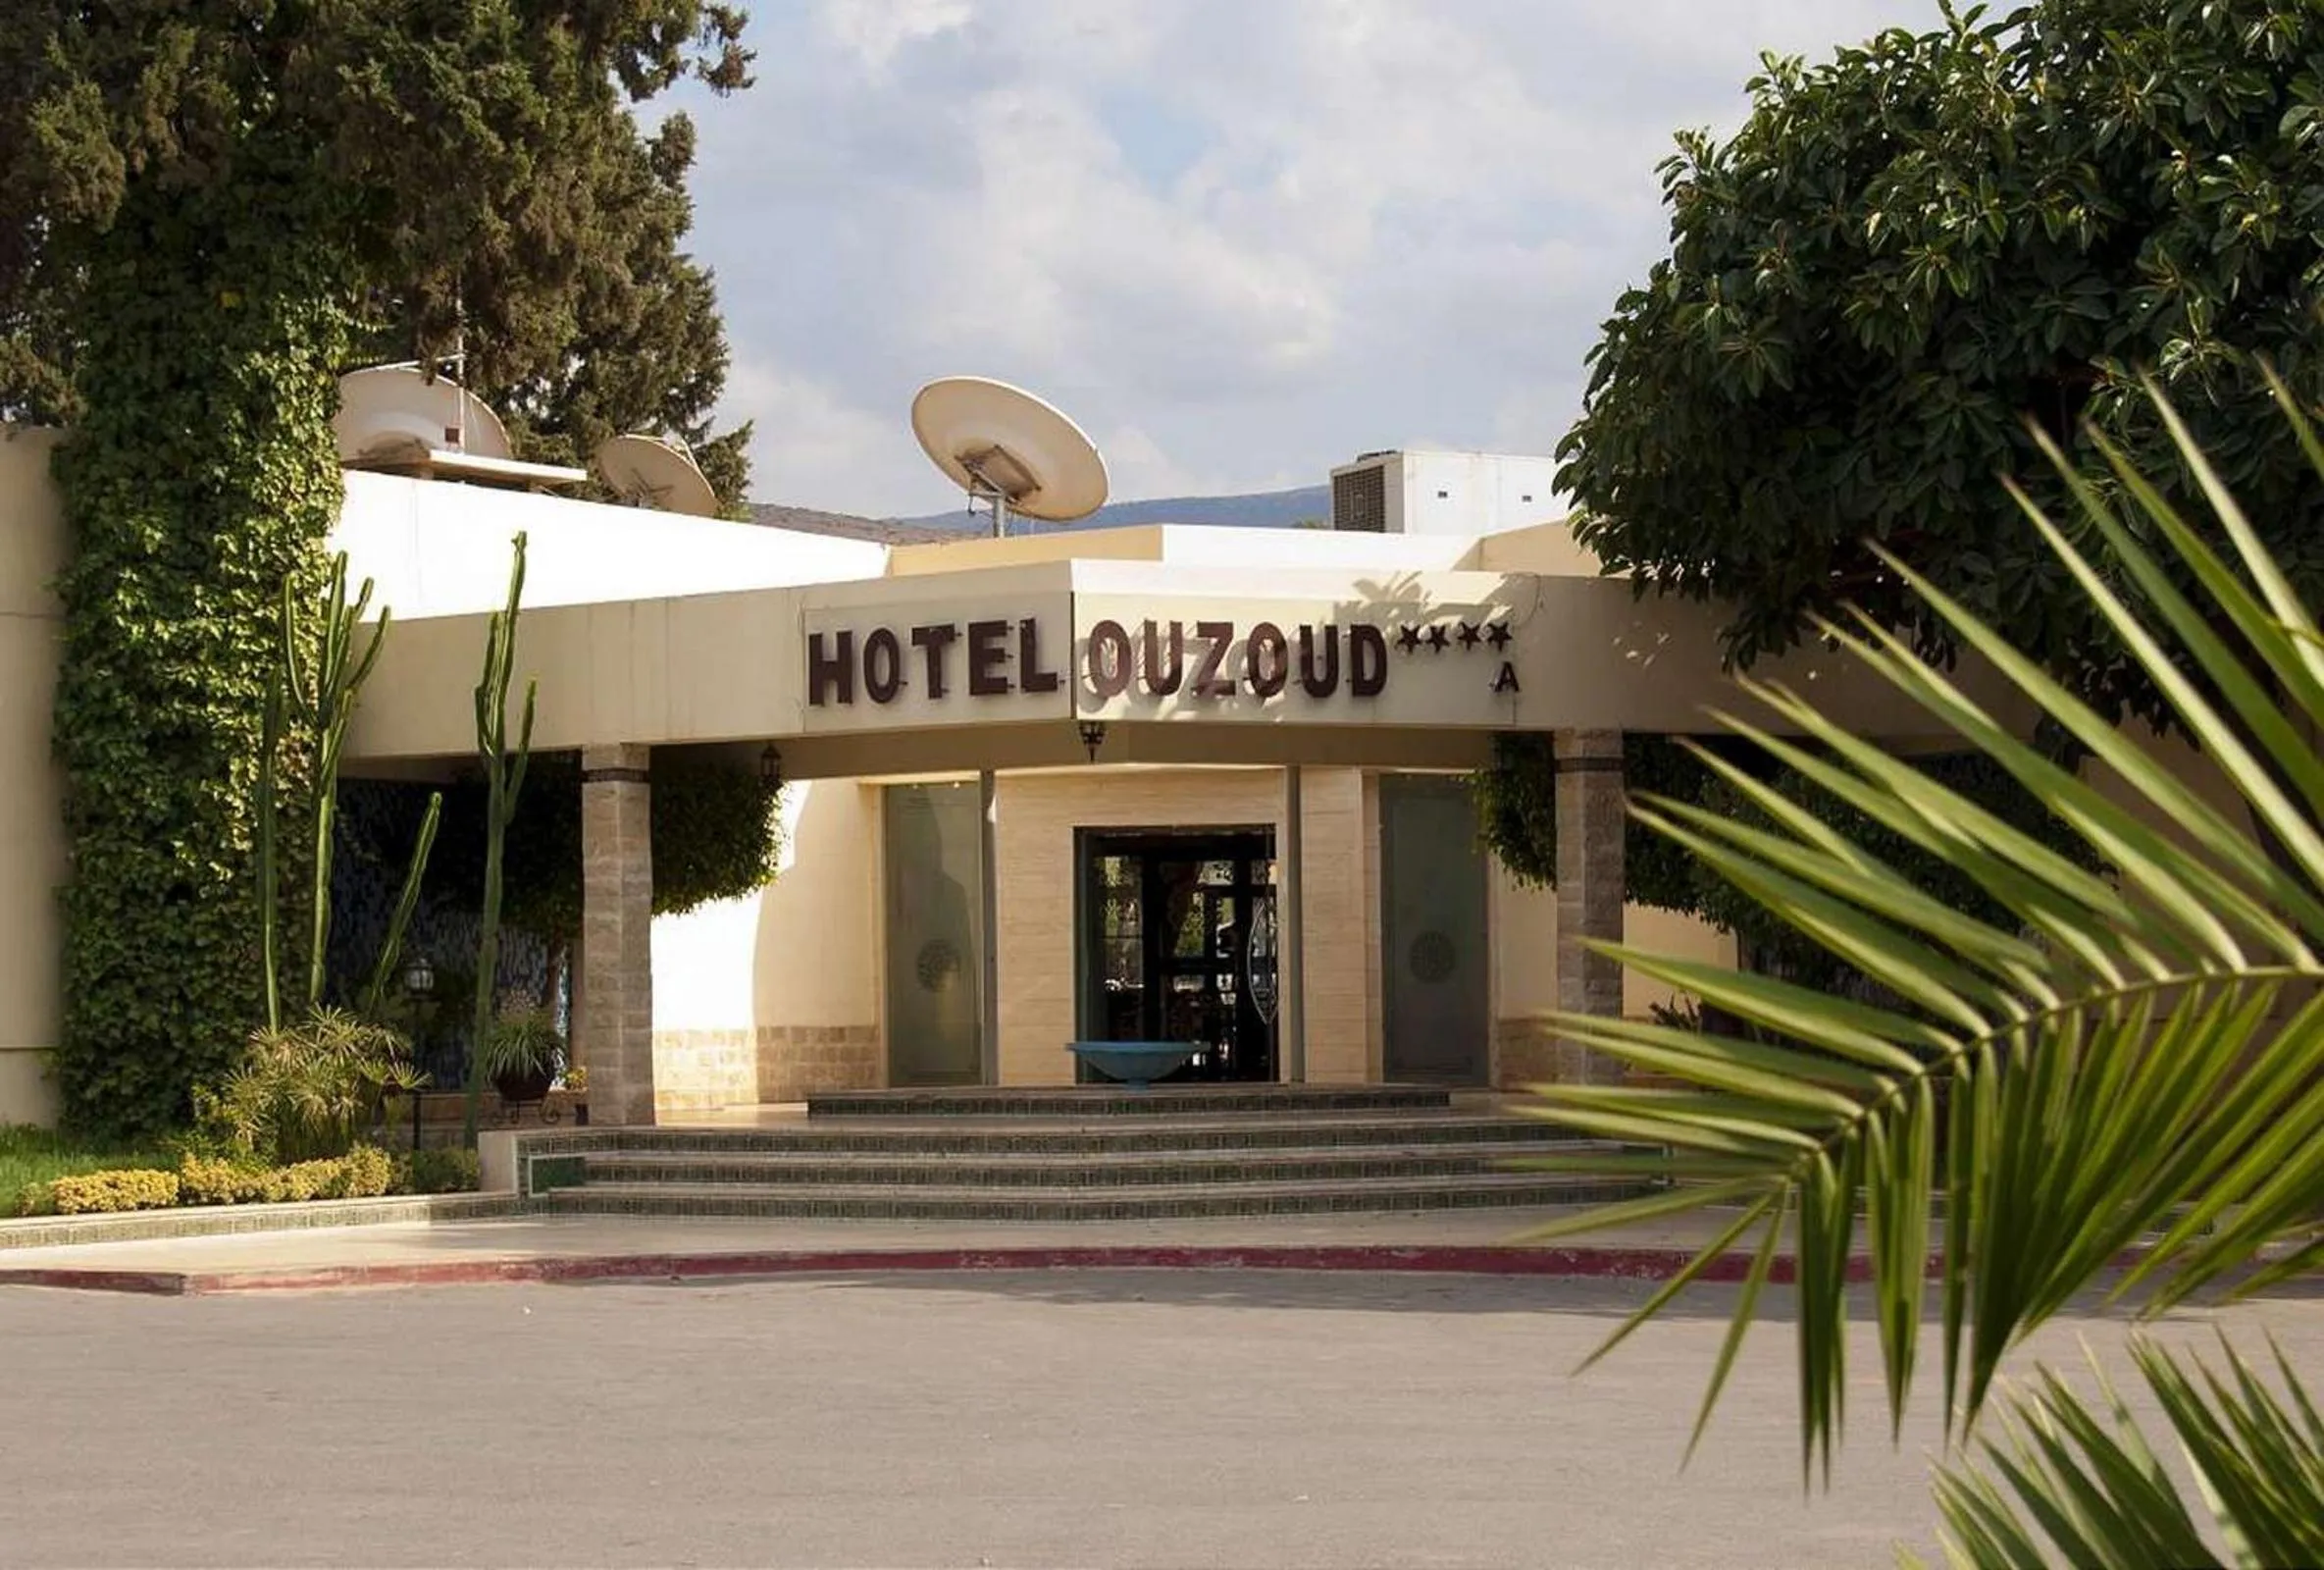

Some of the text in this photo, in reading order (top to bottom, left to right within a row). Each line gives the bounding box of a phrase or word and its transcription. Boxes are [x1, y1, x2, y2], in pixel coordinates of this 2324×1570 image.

[808, 618, 1387, 706] HOTEL OUZOUD
[1494, 661, 1520, 693] A
